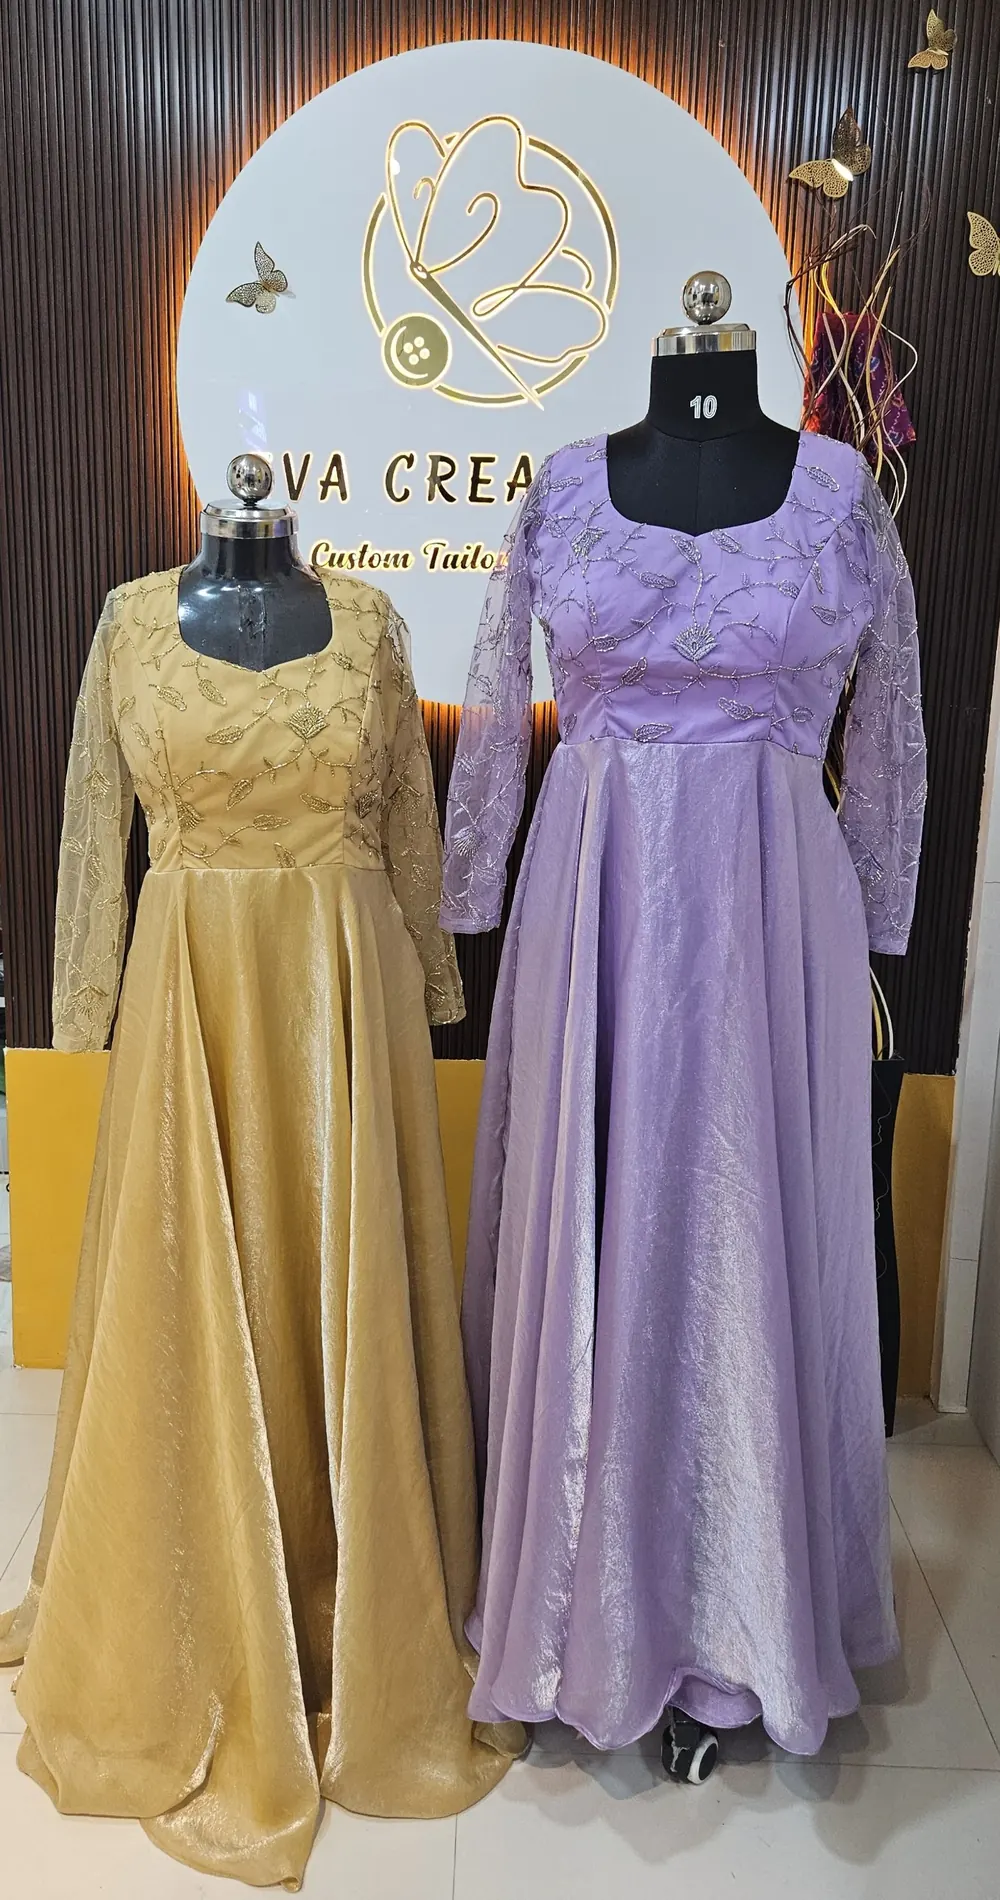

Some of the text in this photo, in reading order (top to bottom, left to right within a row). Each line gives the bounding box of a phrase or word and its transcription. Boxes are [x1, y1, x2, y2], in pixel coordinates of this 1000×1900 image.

[689, 394, 718, 419] 10
[266, 451, 533, 502] VA CREA
[311, 541, 411, 570] Custom
